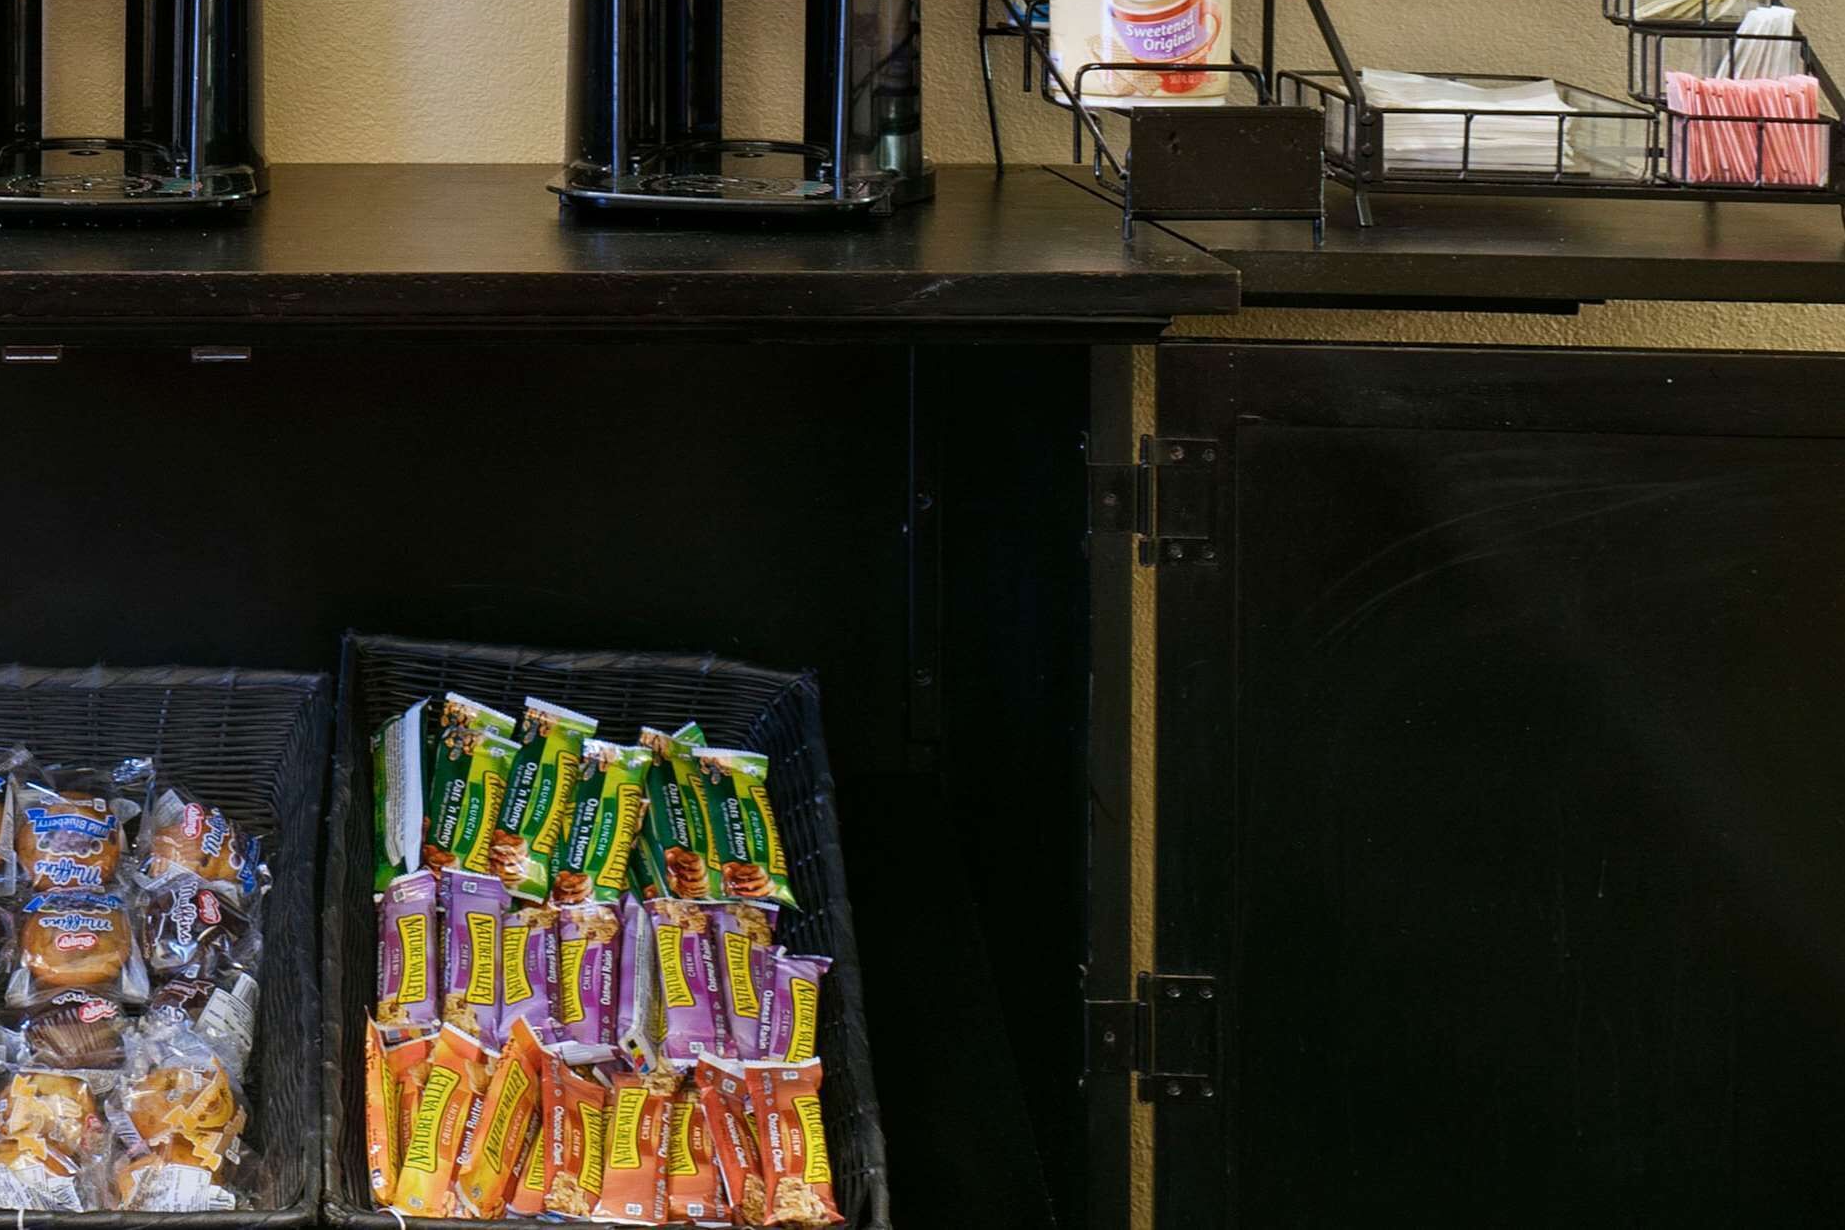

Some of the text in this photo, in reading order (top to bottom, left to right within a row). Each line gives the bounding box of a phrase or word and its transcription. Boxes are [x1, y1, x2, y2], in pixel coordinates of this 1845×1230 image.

[1125, 15, 1194, 38] Sweetened
[1143, 30, 1196, 52] Original
[449, 779, 465, 803] Oats
[521, 761, 538, 786] Oats
[465, 797, 480, 841] CRUNCHY
[506, 798, 527, 831] Honey
[533, 779, 552, 823] CRUNCHY
[438, 815, 458, 848] Honey
[597, 811, 613, 858] CRUNCHY
[35, 856, 103, 886] Muffins
[39, 914, 114, 932] Muffins
[402, 919, 426, 999] NATURE VALLEY
[470, 919, 494, 1002] NATURE VALLEY
[600, 949, 613, 1006] Oatmeal Raisin
[759, 990, 774, 1050] Oatmeal Raisin
[407, 1068, 454, 1166] NATURE VALLEY
[441, 1103, 460, 1146] CRUNCHY
[613, 1089, 645, 1167] NATURE VALLEY
